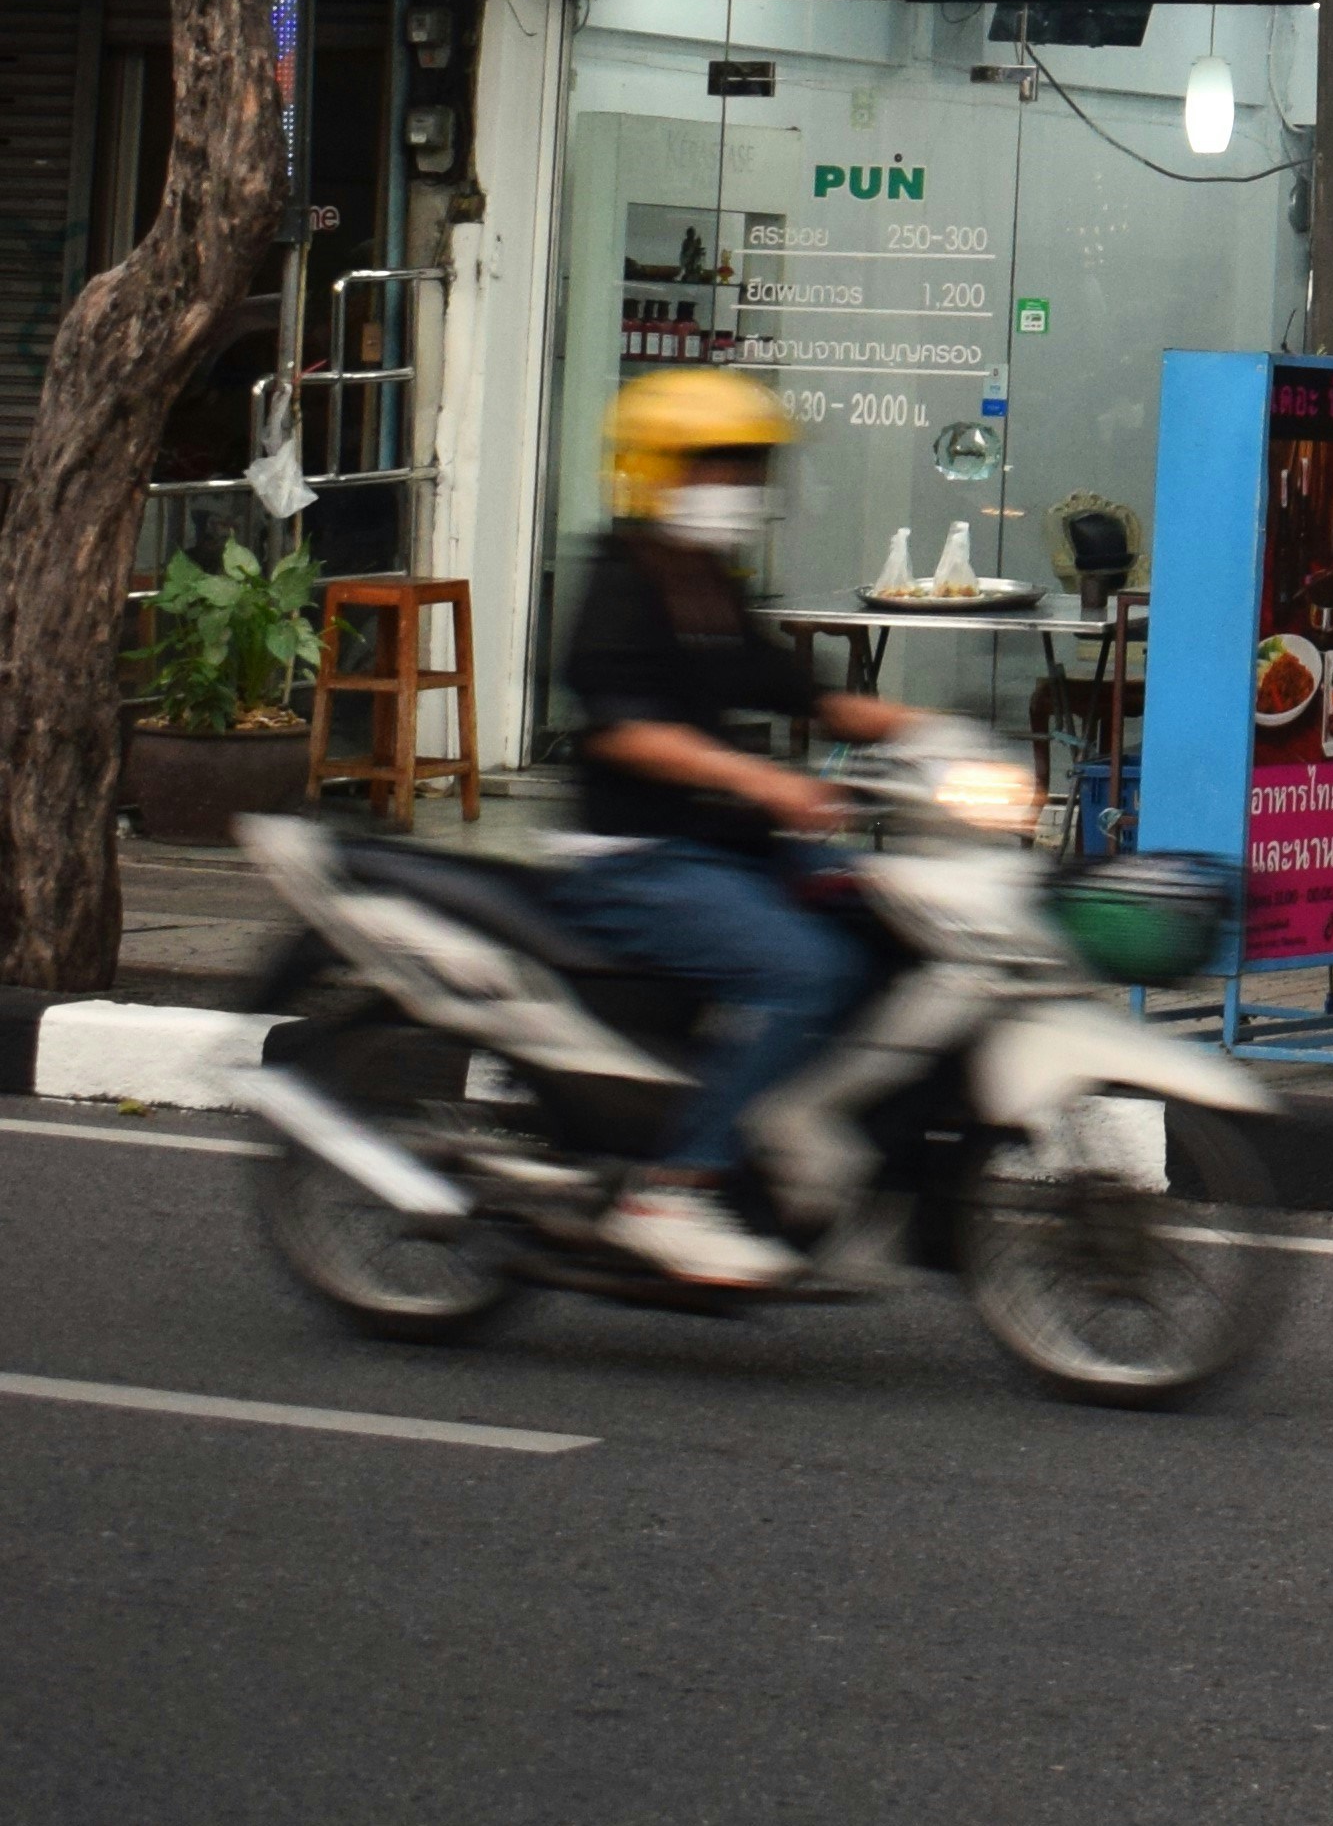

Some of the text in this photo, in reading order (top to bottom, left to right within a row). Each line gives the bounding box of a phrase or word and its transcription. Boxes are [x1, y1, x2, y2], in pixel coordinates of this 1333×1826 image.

[814, 164, 926, 201] PUN
[887, 223, 988, 251] 250-300
[922, 282, 986, 310] 1,200
[850, 394, 909, 426] 20.00
